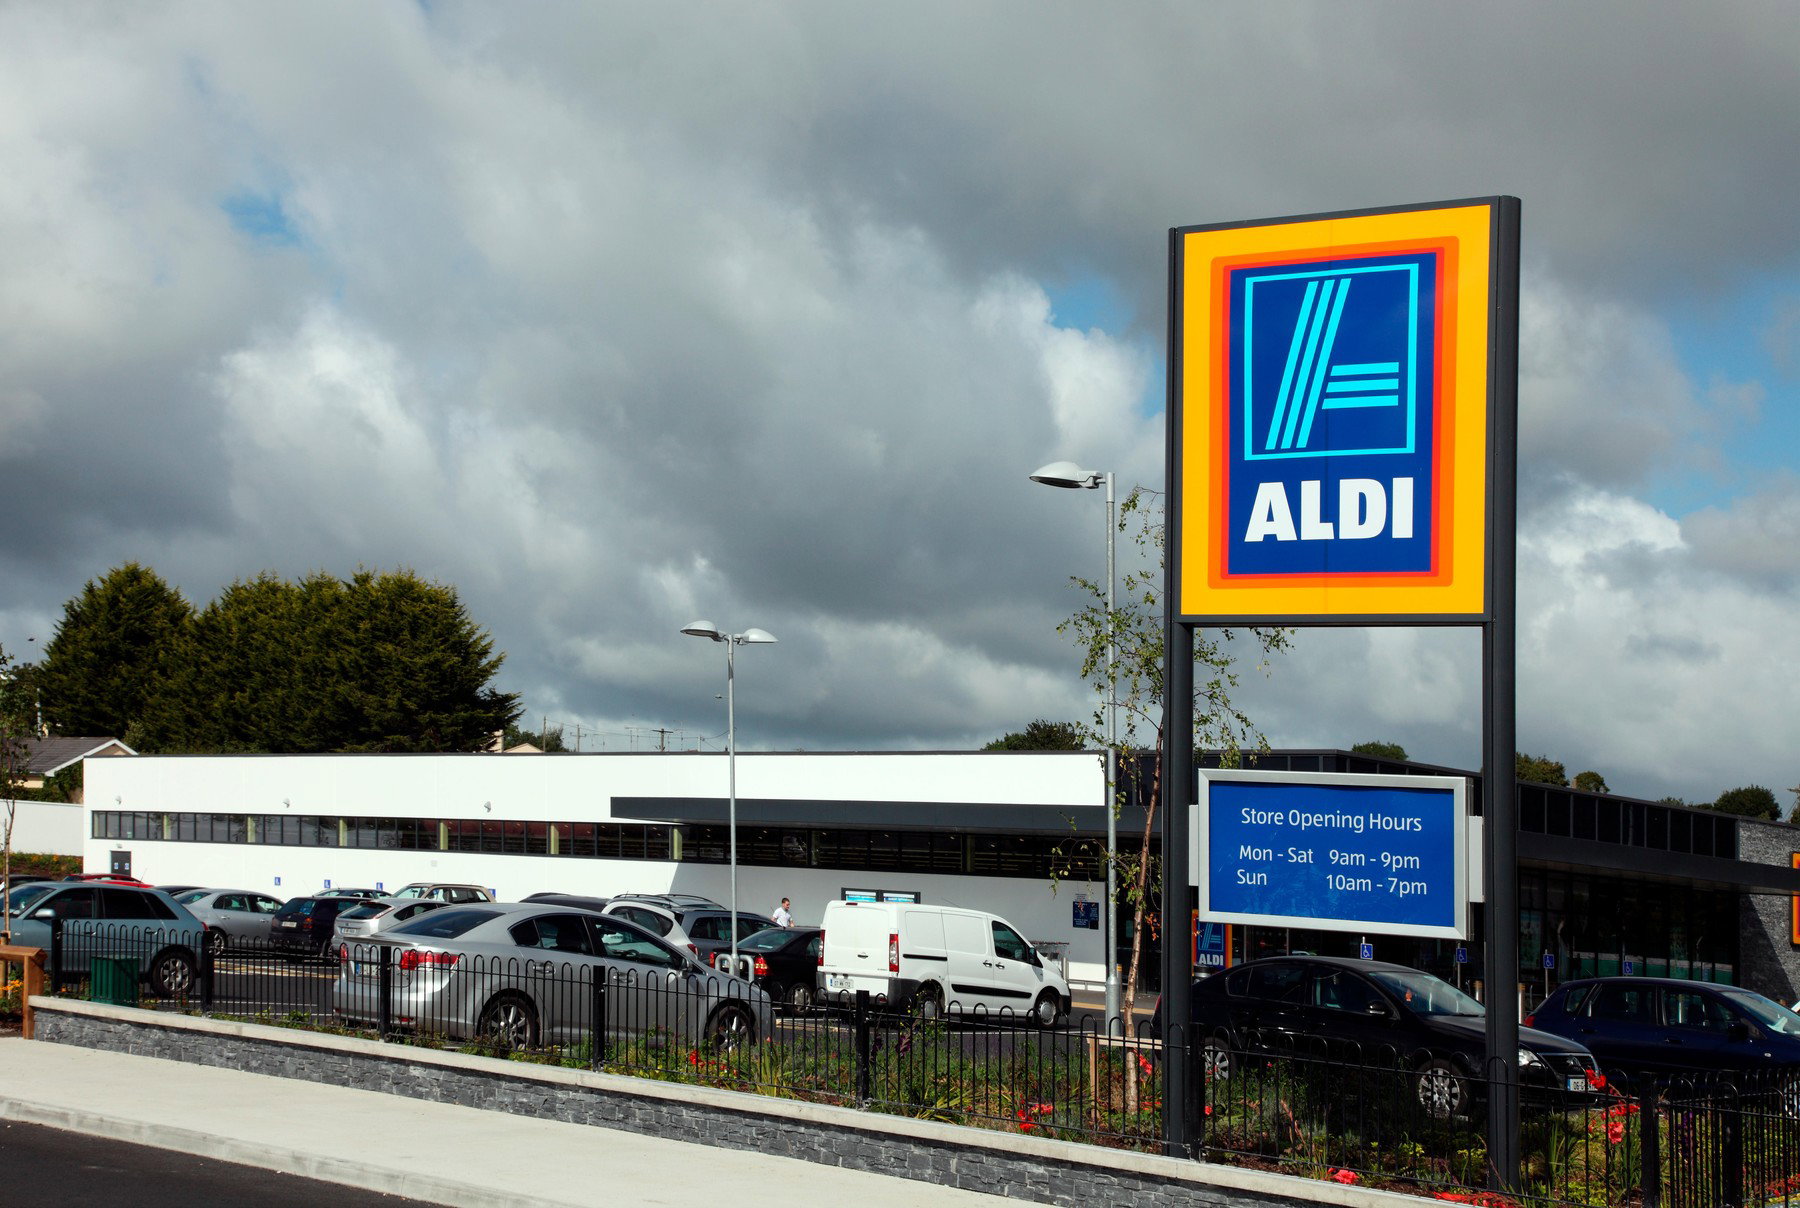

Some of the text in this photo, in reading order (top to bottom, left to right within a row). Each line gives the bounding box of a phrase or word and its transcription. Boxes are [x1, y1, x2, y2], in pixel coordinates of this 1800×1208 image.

[1244, 477, 1414, 542] ALDI
[1241, 808, 1422, 834] Store Opening Hours
[1239, 845, 1273, 861] Mon
[1287, 847, 1314, 864] Sat
[1329, 850, 1365, 866] 9am
[1380, 852, 1420, 872] 9pm
[1236, 869, 1267, 886] Sun
[1326, 875, 1372, 892] 10am
[1388, 877, 1427, 898] 7pm
[1199, 953, 1224, 966] ALDI
